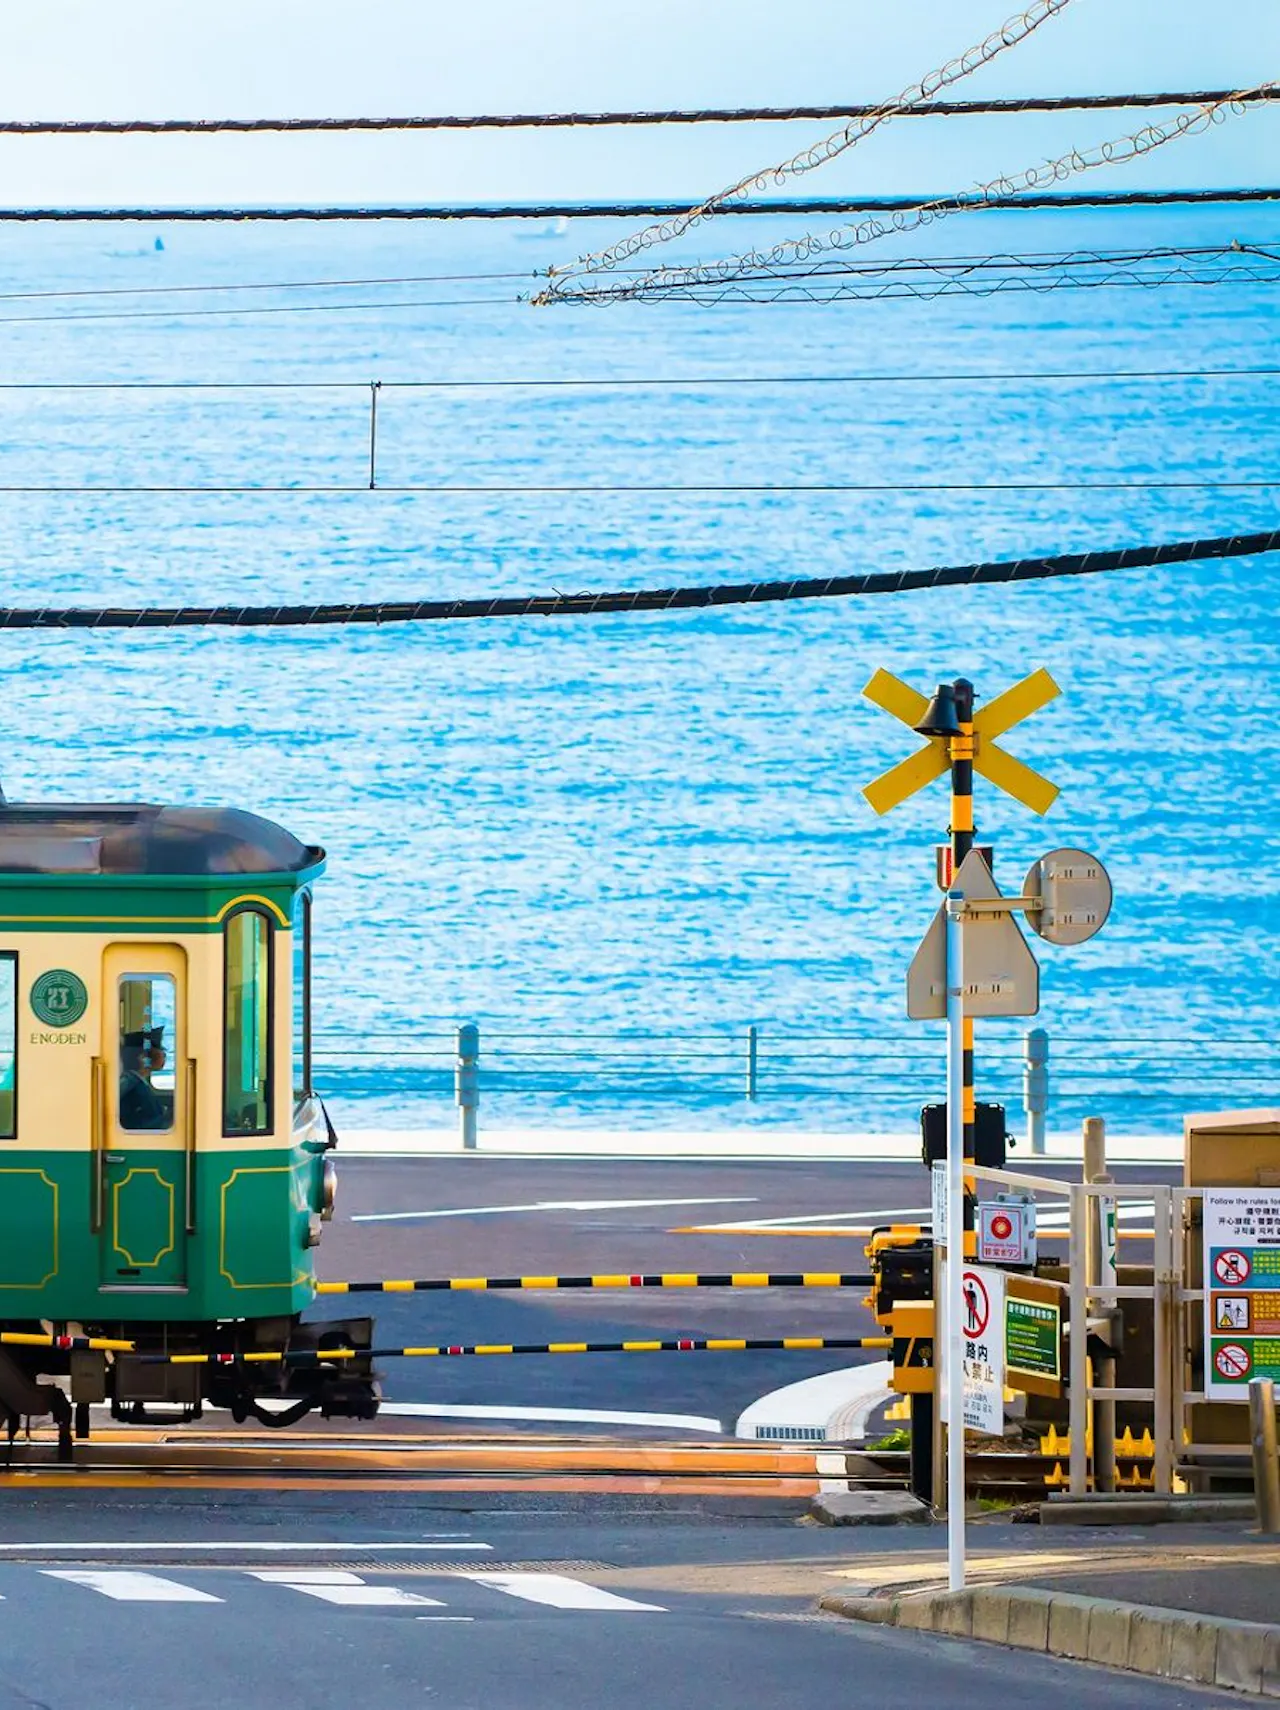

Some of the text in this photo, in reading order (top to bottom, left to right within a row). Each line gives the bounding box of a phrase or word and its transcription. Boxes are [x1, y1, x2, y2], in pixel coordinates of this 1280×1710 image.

[30, 1033, 86, 1045] ENODEN
[1210, 1197, 1234, 1205] Follow
[1235, 1197, 1248, 1205] the
[1250, 1197, 1268, 1205] rules
[965, 1341, 988, 1362] 路内
